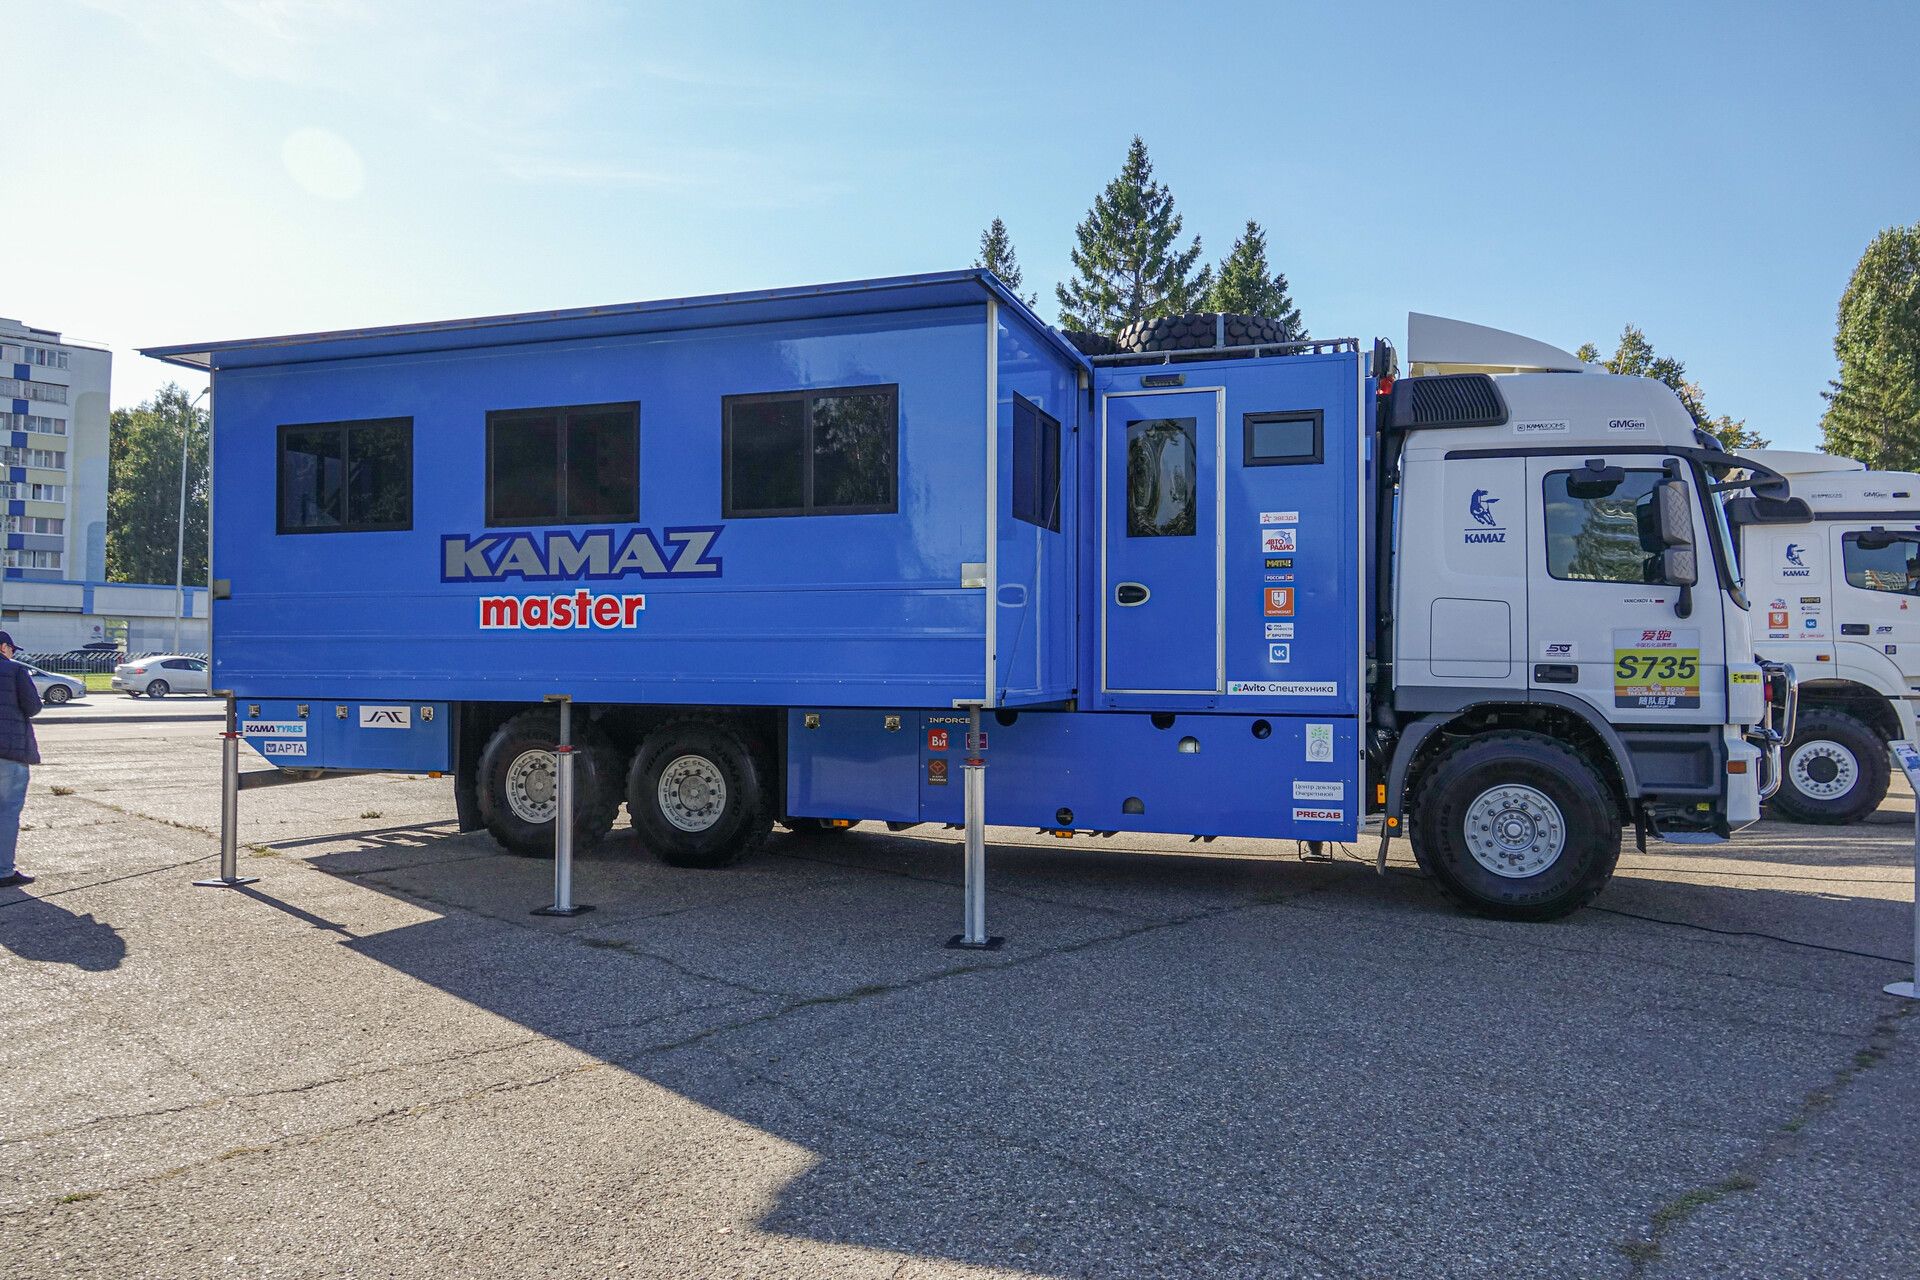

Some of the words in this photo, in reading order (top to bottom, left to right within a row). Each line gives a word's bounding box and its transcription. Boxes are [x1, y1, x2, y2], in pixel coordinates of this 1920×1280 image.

[1464, 533, 1506, 543] KAMAZ
[441, 525, 725, 583] KAMAZ
[479, 588, 645, 629] master
[1616, 655, 1697, 680] S735
[1242, 683, 1266, 692] Avito
[1268, 683, 1334, 693] Спецтехника
[275, 725, 303, 733] TYRES
[1296, 811, 1341, 819] PRECAB
